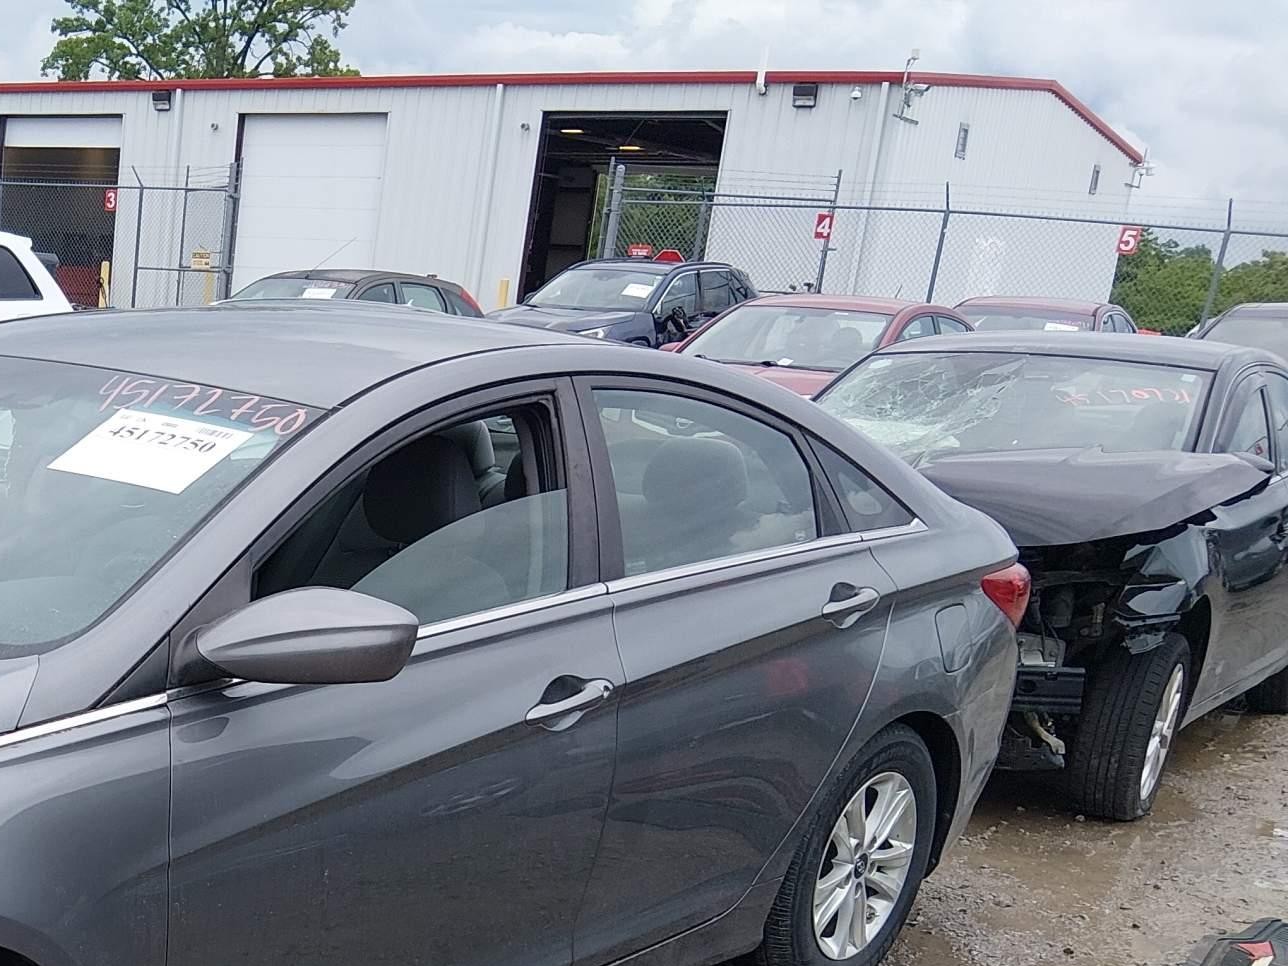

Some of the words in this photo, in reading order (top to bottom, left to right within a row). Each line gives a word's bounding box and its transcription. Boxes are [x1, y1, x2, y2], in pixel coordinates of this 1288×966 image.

[106, 192, 116, 208] 3
[816, 216, 831, 237] 4
[1119, 230, 1138, 251] 5
[99, 375, 309, 436] 45172750
[109, 424, 217, 453] 45172750
